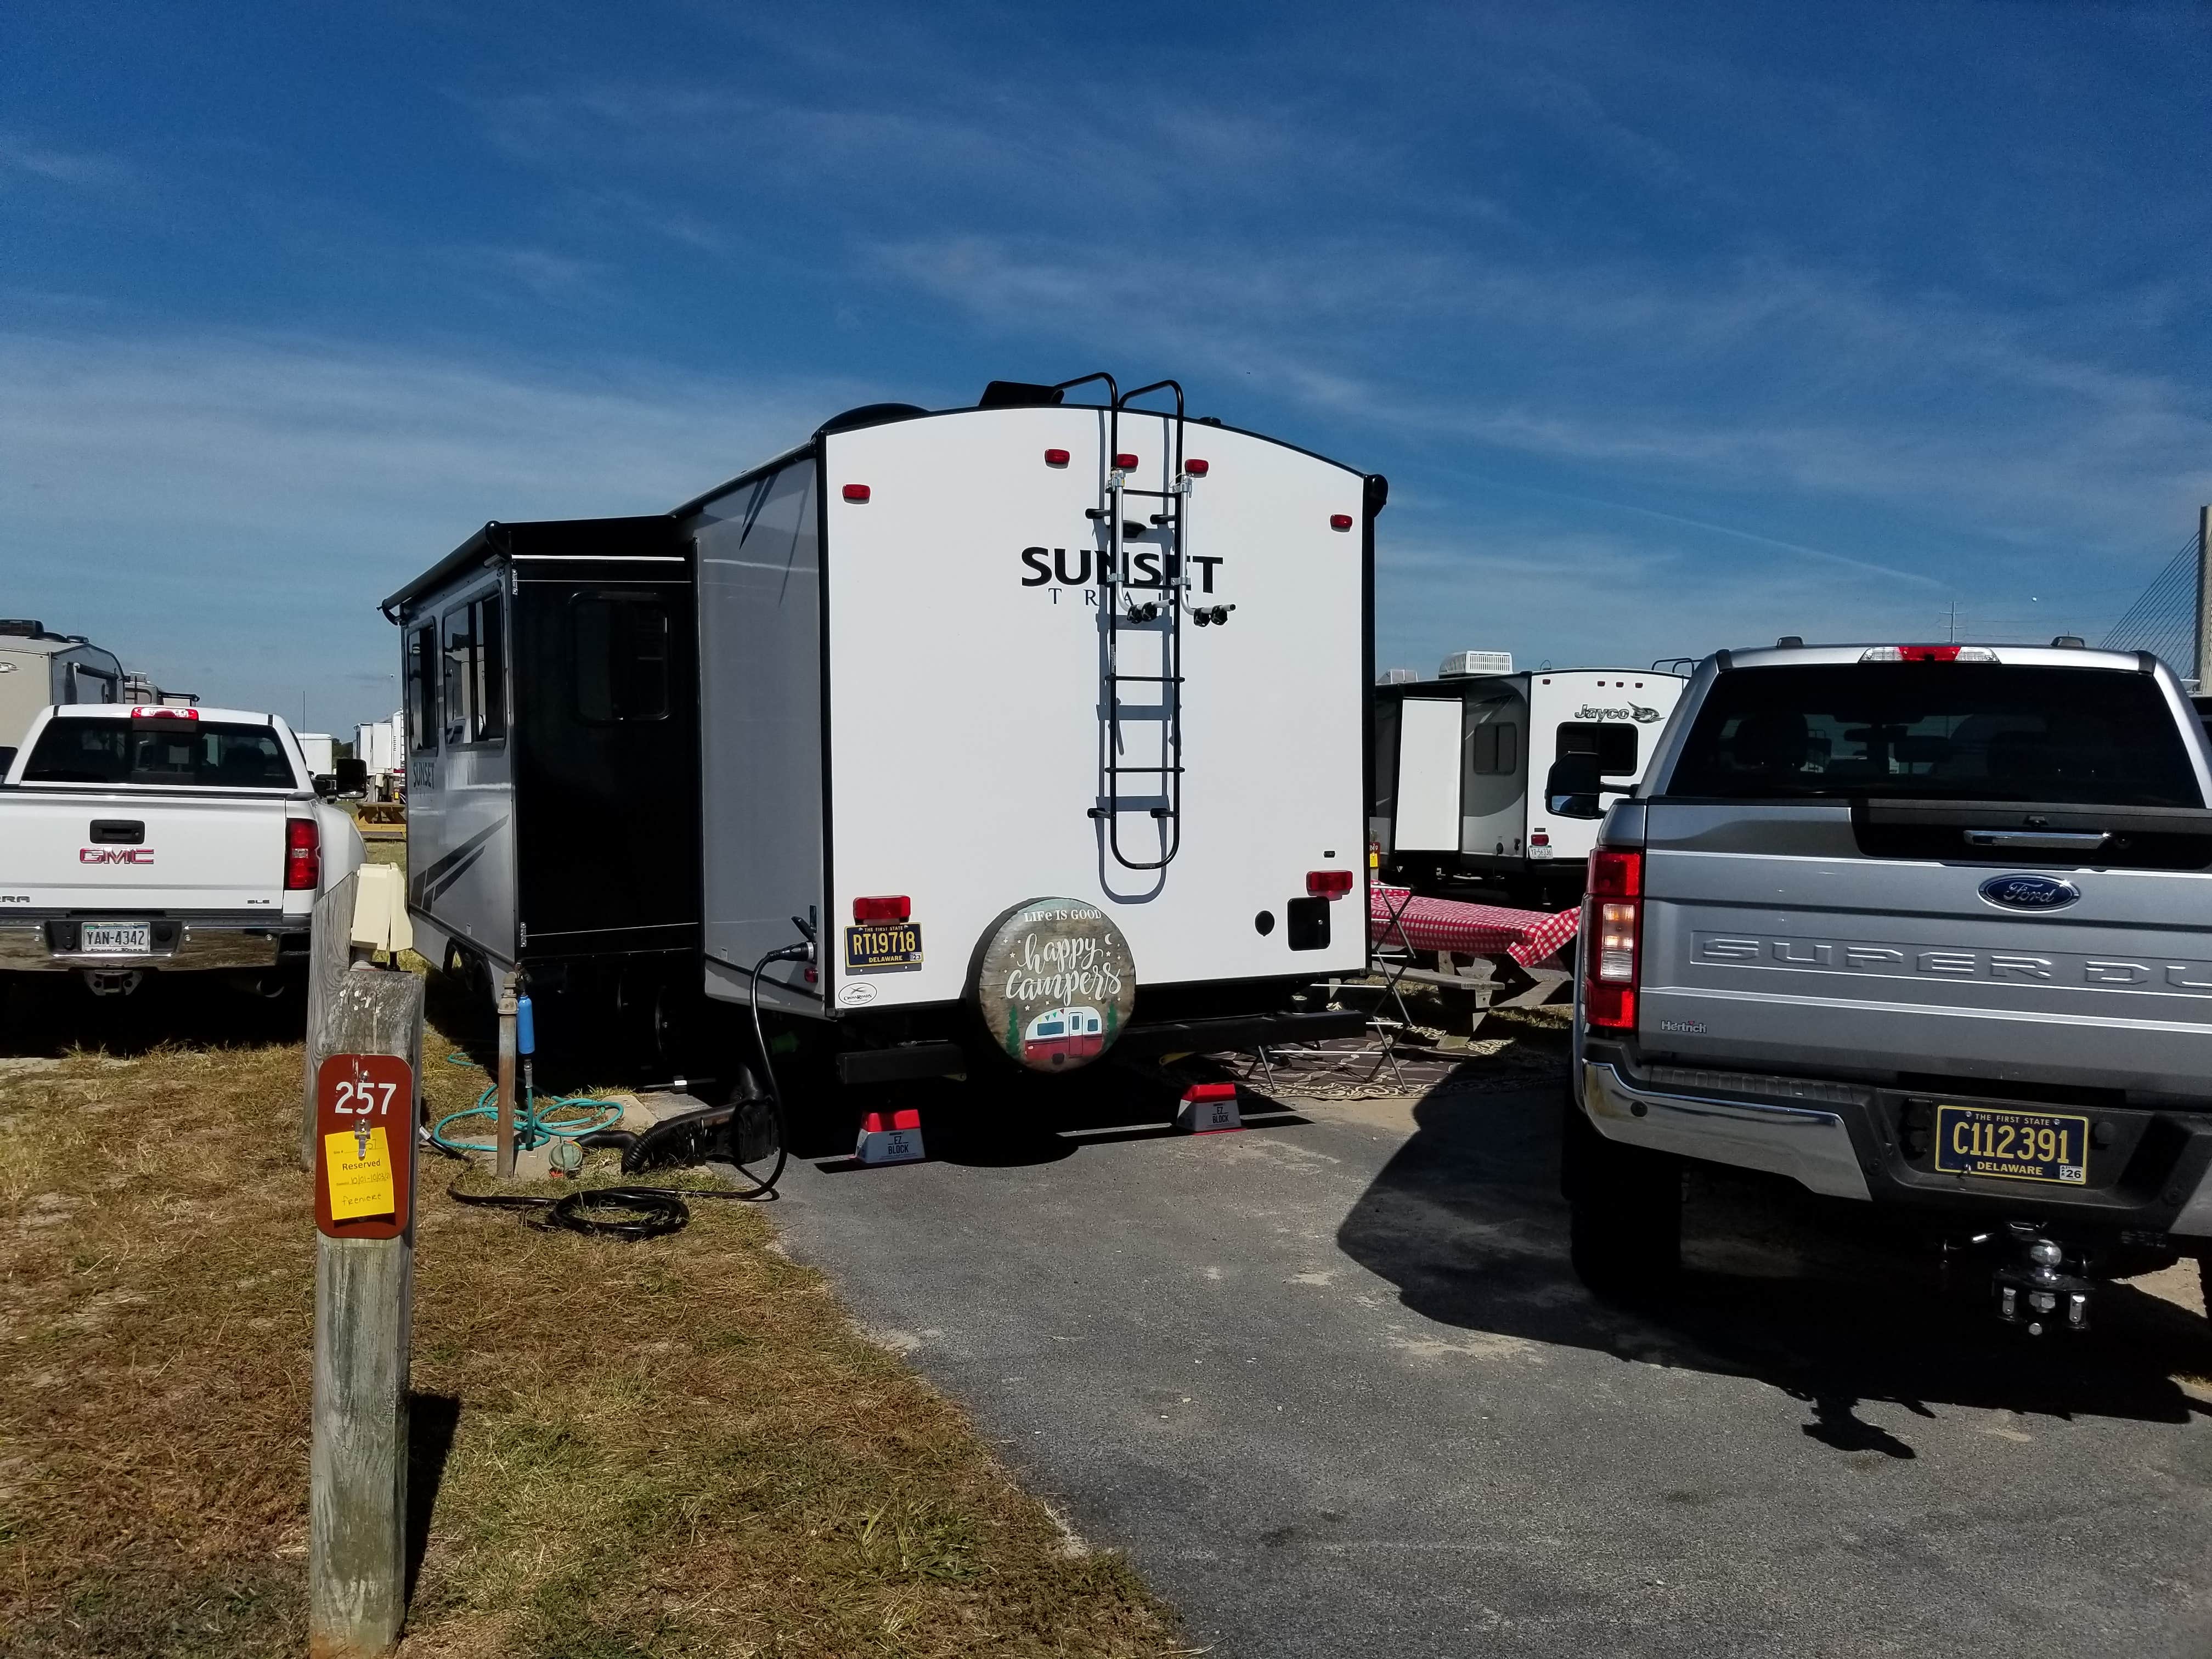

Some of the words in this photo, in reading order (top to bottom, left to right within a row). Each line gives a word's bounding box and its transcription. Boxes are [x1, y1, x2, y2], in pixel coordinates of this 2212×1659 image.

[1022, 546, 1223, 594] SUNSET
[1048, 588, 1189, 607] TRAI
[1574, 704, 1629, 723] Jayco
[413, 762, 435, 790] SUNSET
[80, 848, 154, 865] GMC
[2002, 881, 2057, 903] Ford
[1056, 910, 1068, 921] IS
[1071, 909, 1102, 920] GOOD
[87, 930, 144, 945] YAN-4342
[853, 931, 916, 955] RT19718
[1017, 933, 1104, 974] happy
[1703, 937, 2052, 979] SUPER
[1661, 1020, 1707, 1034] Hertrich
[335, 1081, 397, 1115] 257
[1212, 1115, 1229, 1124] BLOCK
[1976, 1113, 1991, 1121] THE
[1996, 1115, 2019, 1124] FIRST
[2024, 1117, 2050, 1126] STATE
[888, 1144, 909, 1154] BLOCK
[894, 1136, 902, 1145] EZ
[1953, 1121, 2069, 1164] C112391
[342, 1158, 381, 1171] Reserved
[1977, 1161, 2043, 1176] DELAWARE
[2066, 1169, 2081, 1178] 26
